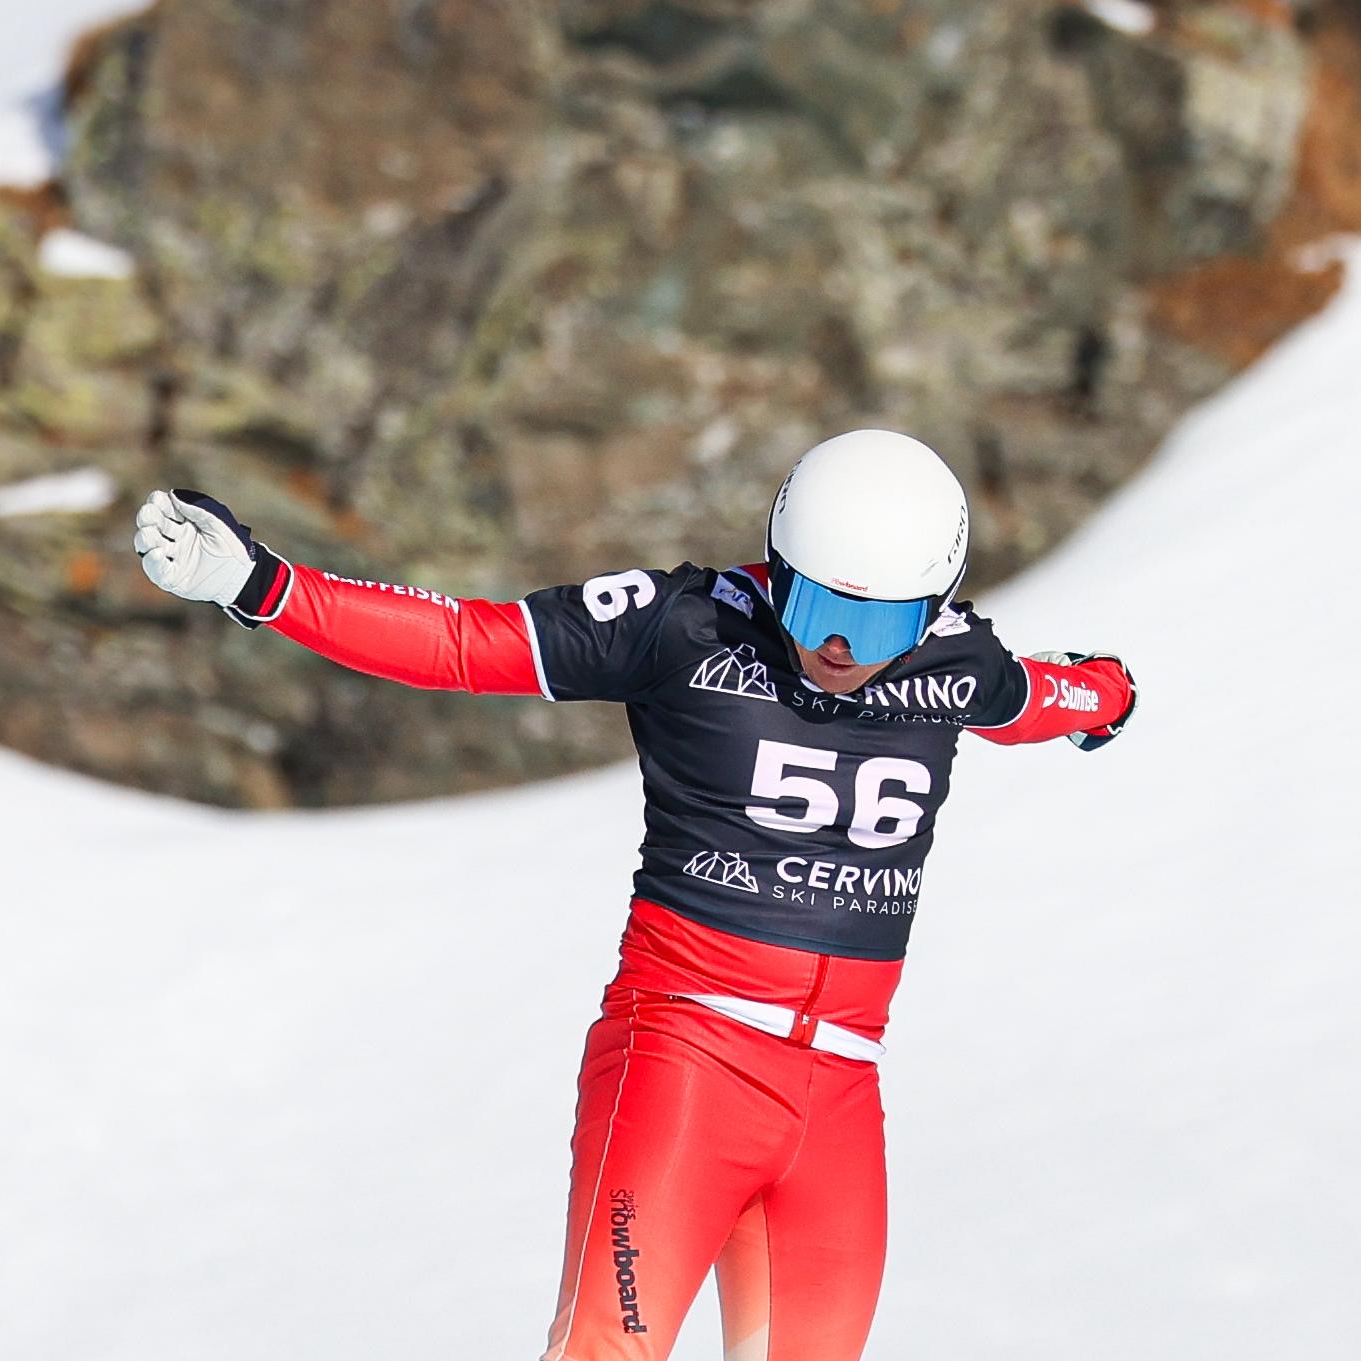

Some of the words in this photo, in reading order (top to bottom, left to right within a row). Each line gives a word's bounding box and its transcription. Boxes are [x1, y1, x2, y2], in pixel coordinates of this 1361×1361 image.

[792, 691, 840, 715] SKI
[745, 739, 931, 849] 56
[776, 856, 922, 897] CERVINO
[772, 885, 816, 906] SKI
[833, 897, 918, 915] PARADISE
